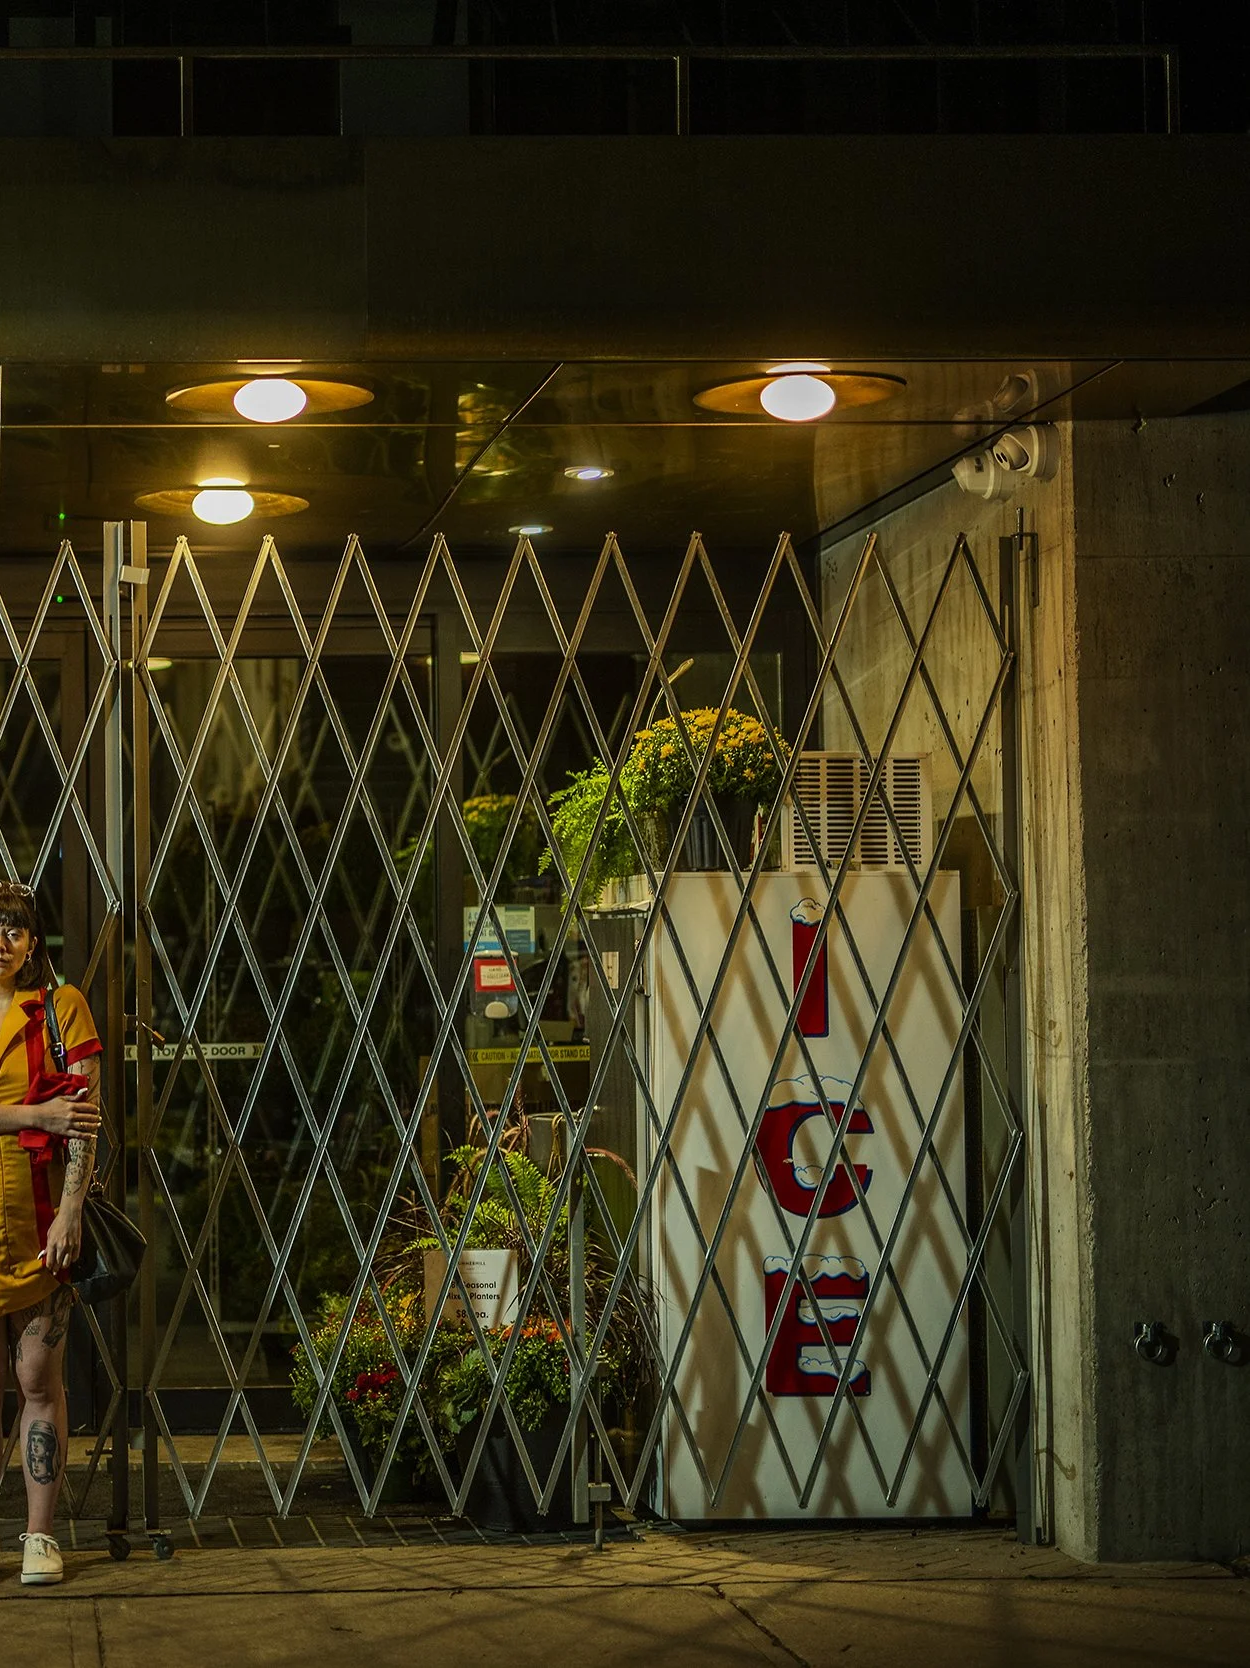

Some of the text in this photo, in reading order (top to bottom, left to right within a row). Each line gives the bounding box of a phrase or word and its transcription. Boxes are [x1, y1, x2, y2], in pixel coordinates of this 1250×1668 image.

[211, 1046, 246, 1056] DOOR
[481, 1052, 506, 1061] CAUTION
[753, 897, 875, 1397] ICE
[470, 1292, 500, 1300] Planters
